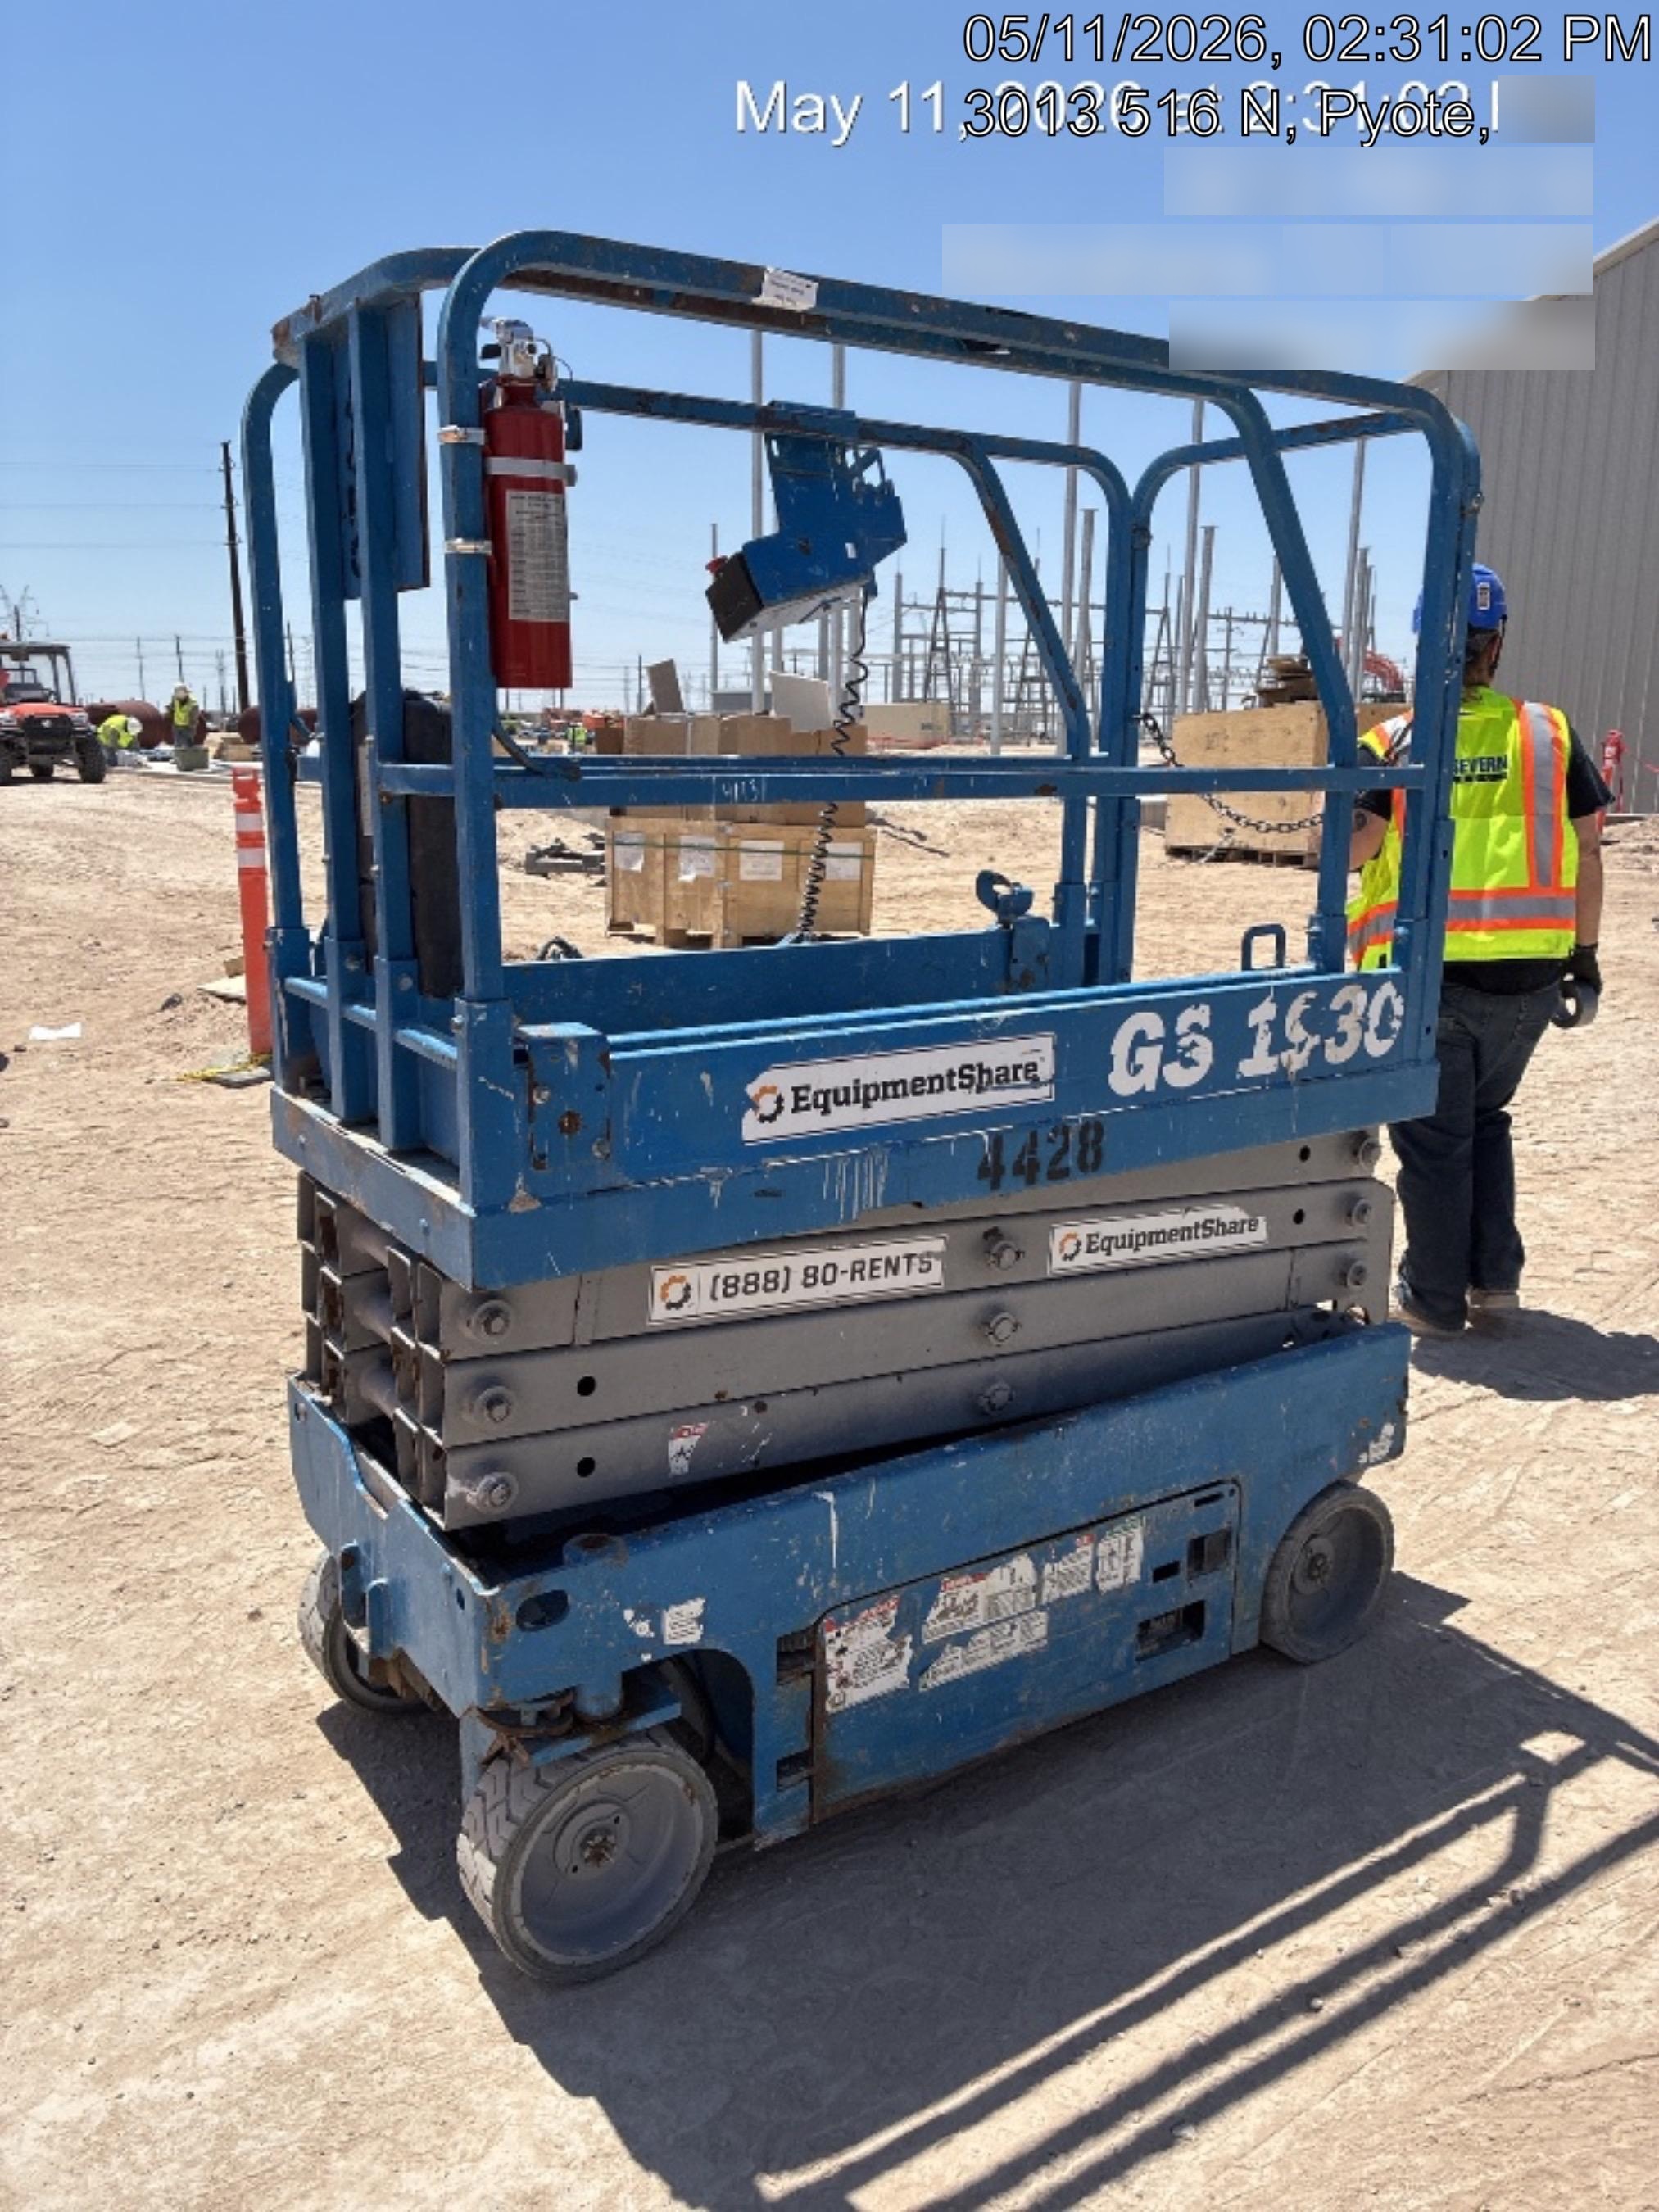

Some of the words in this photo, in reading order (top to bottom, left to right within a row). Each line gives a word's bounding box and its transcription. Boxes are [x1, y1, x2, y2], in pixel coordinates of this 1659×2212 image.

[1107, 1003, 1214, 1097] GS
[790, 1060, 1040, 1117] EquipmentShare
[977, 1119, 1105, 1191] 4428
[1086, 1216, 1260, 1256] EquipmentShare
[709, 1264, 791, 1303] (888)
[800, 1252, 934, 1290] 80-RENTS
